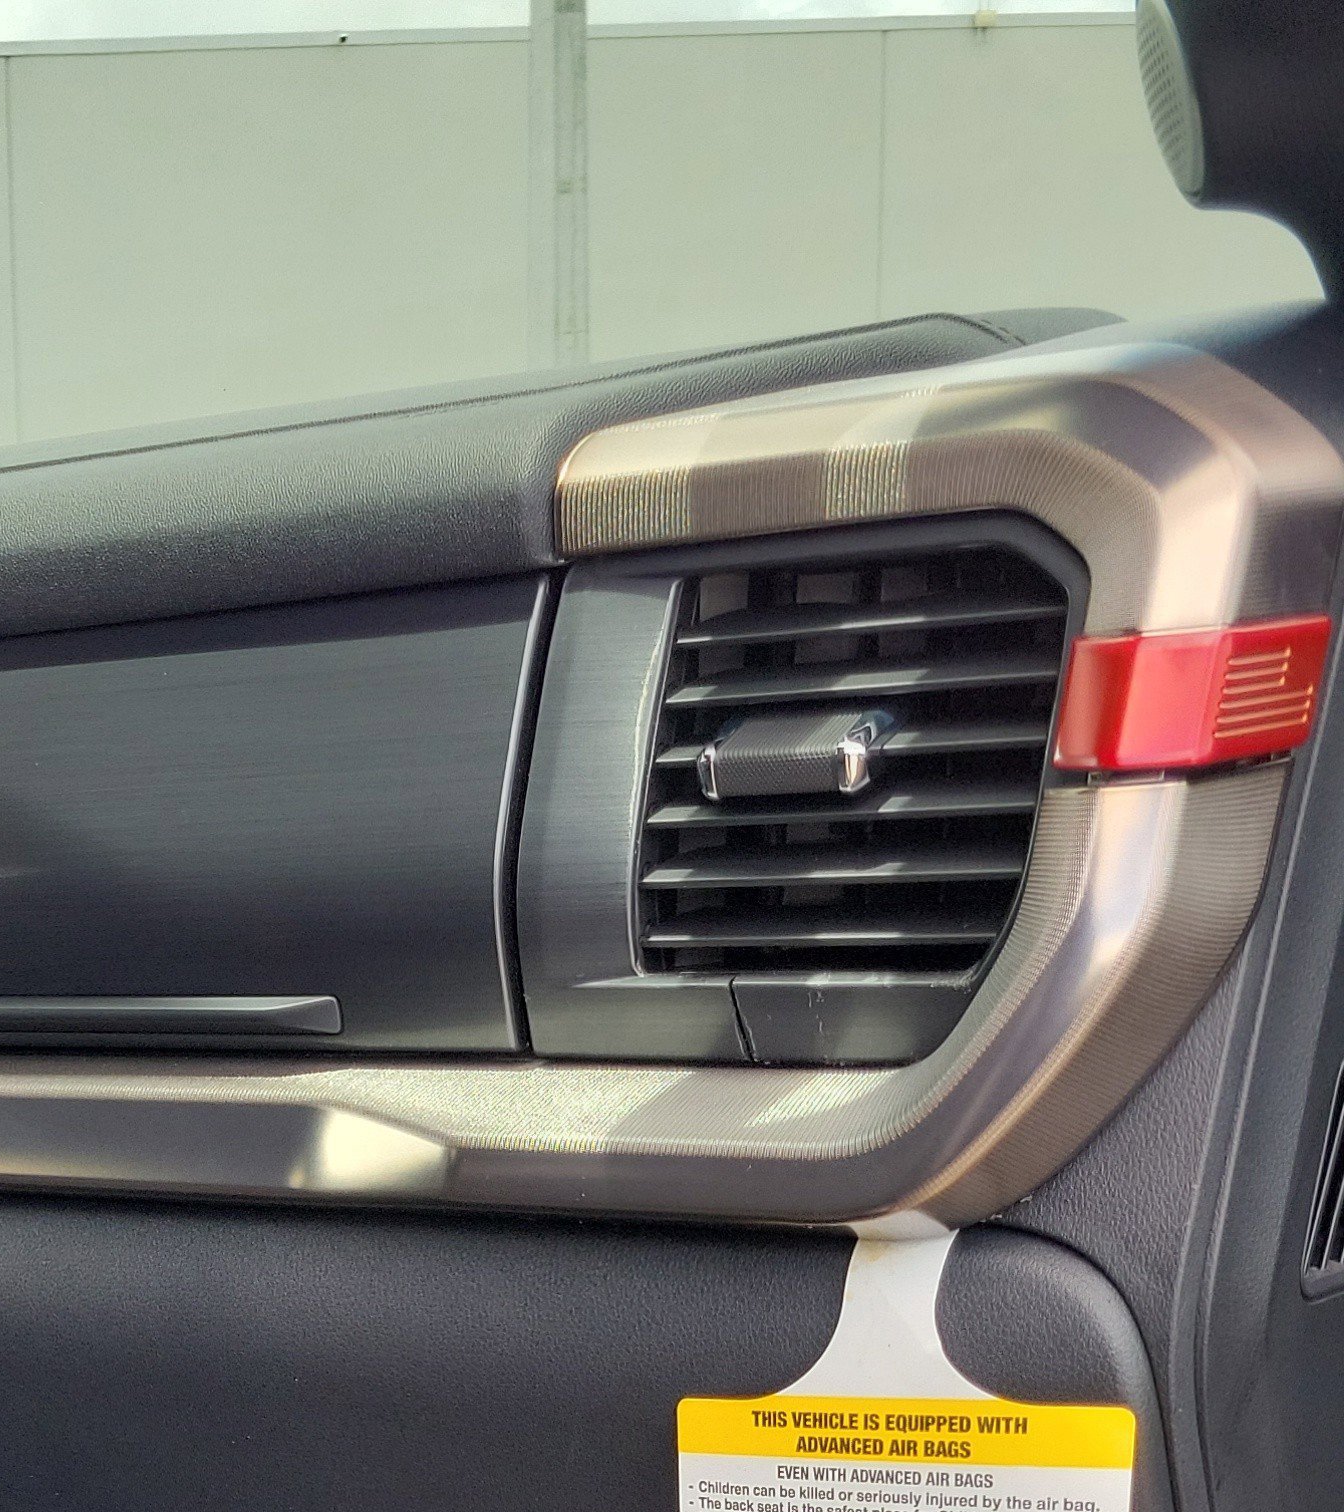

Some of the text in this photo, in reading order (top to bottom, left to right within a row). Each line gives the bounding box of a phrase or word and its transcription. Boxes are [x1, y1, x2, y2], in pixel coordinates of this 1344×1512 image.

[752, 1411, 1028, 1435] THIS VEHICLE IS EQUIPPED WITH
[796, 1436, 972, 1459] ADVANCED AIR BAGS
[777, 1465, 994, 1488] EVEN WITH ADVANCED AIR BAGS
[698, 1480, 750, 1496] Children
[753, 1486, 776, 1498] can
[779, 1484, 796, 1499] be
[799, 1486, 834, 1501] killed
[838, 1491, 853, 1502] or
[856, 1489, 921, 1507] seriously
[925, 1493, 977, 1508] injured
[982, 1494, 1002, 1511] by
[1006, 1495, 1032, 1509] the
[1036, 1497, 1059, 1511] air
[699, 1497, 722, 1510] The
[724, 1498, 754, 1512] back
